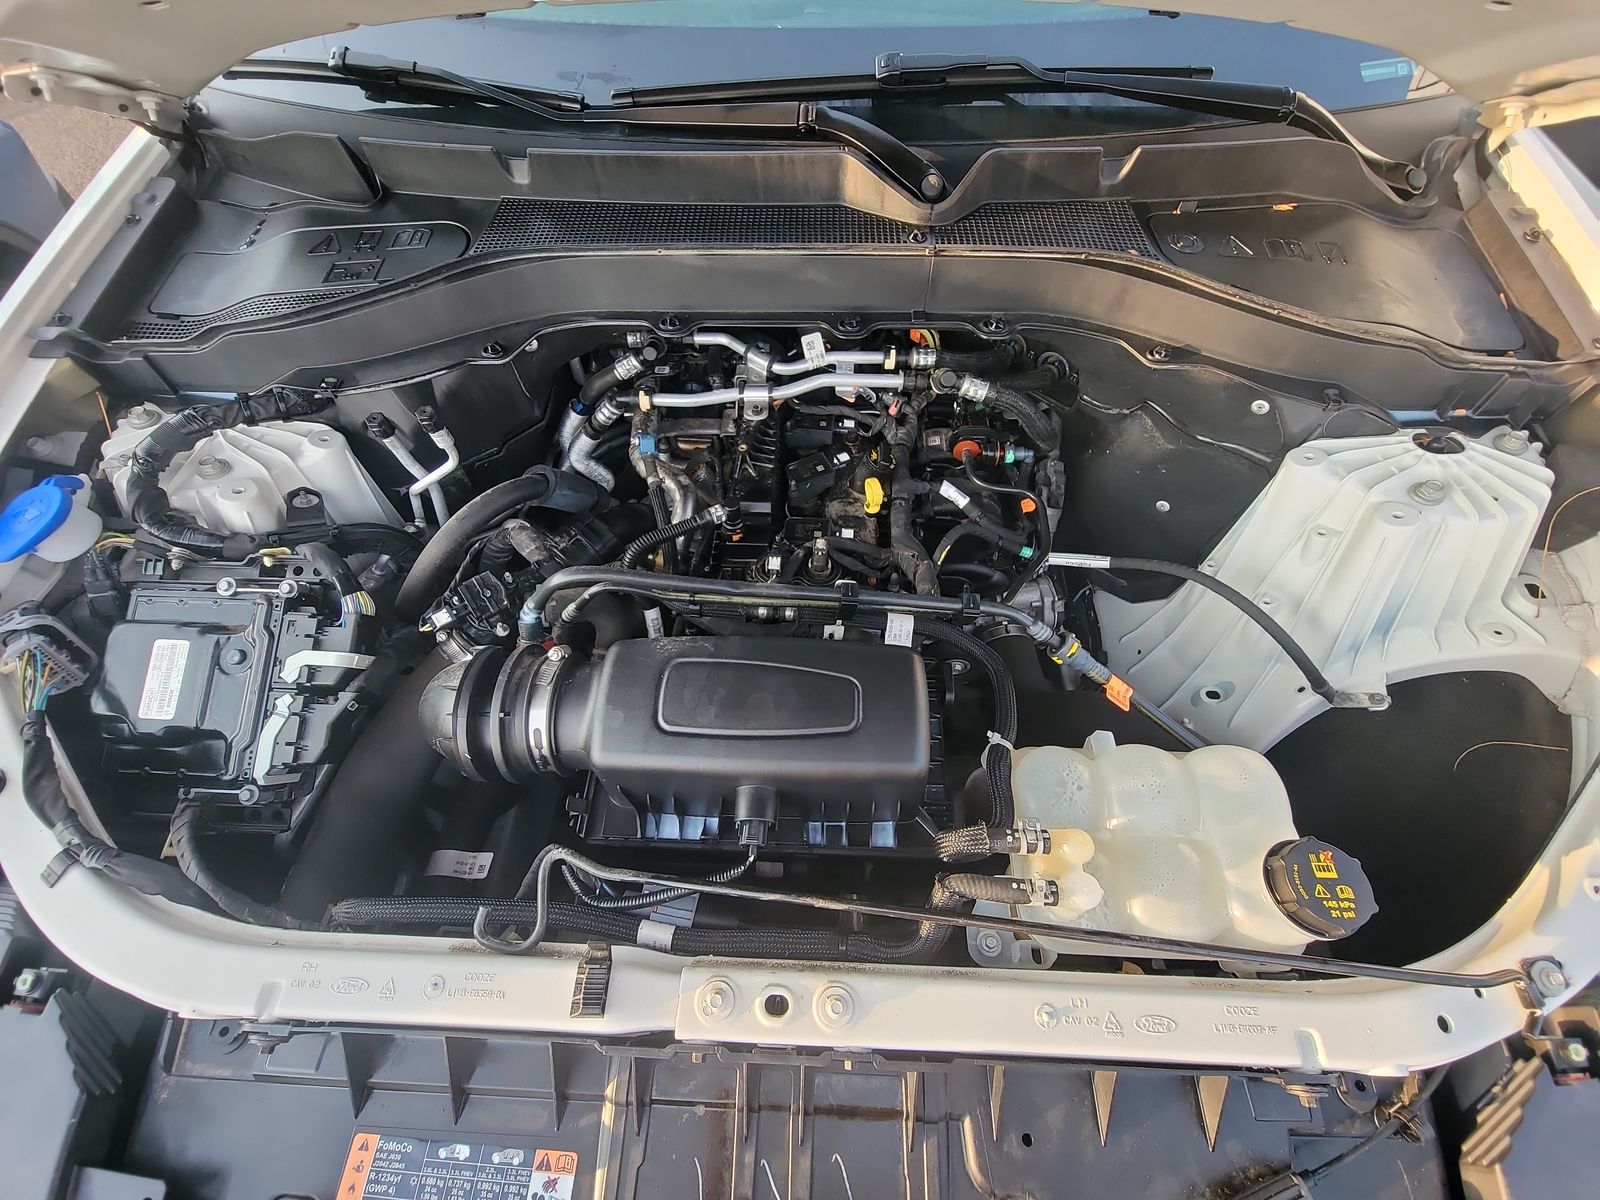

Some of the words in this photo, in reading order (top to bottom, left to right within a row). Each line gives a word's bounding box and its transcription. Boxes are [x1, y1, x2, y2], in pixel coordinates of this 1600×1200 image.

[1322, 900, 1338, 908] 145
[1340, 900, 1356, 909] kPa
[1330, 910, 1341, 918] 21
[334, 978, 366, 993] Ford
[1138, 1017, 1172, 1032] Ford
[378, 1140, 413, 1152] FoMoCo
[375, 1151, 388, 1159] SAE
[388, 1153, 402, 1161] J639
[369, 1171, 403, 1185] R-1234yf
[365, 1183, 388, 1194] (GWP
[388, 1185, 396, 1196] 4)
[463, 1180, 471, 1191] kg
[492, 1182, 501, 1193] kg
[519, 1185, 528, 1196] kg
